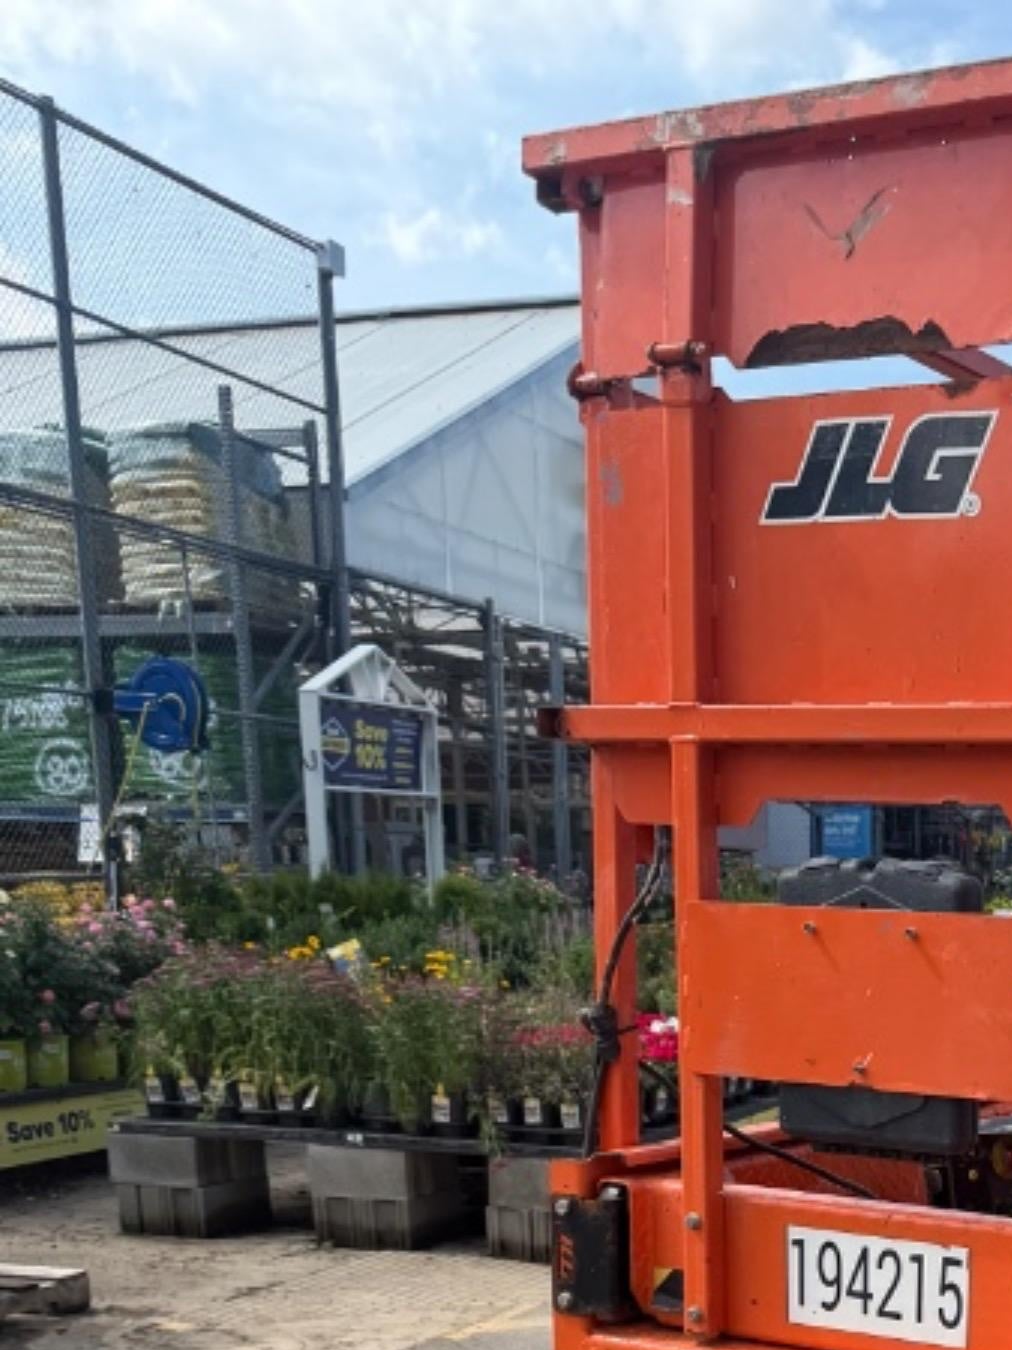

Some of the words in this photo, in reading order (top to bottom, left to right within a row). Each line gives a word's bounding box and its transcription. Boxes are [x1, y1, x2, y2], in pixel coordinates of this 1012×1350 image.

[760, 411, 998, 525] JLG
[6, 1120, 55, 1144] Save
[58, 1109, 95, 1134] 10%
[791, 1238, 964, 1330] 194215
